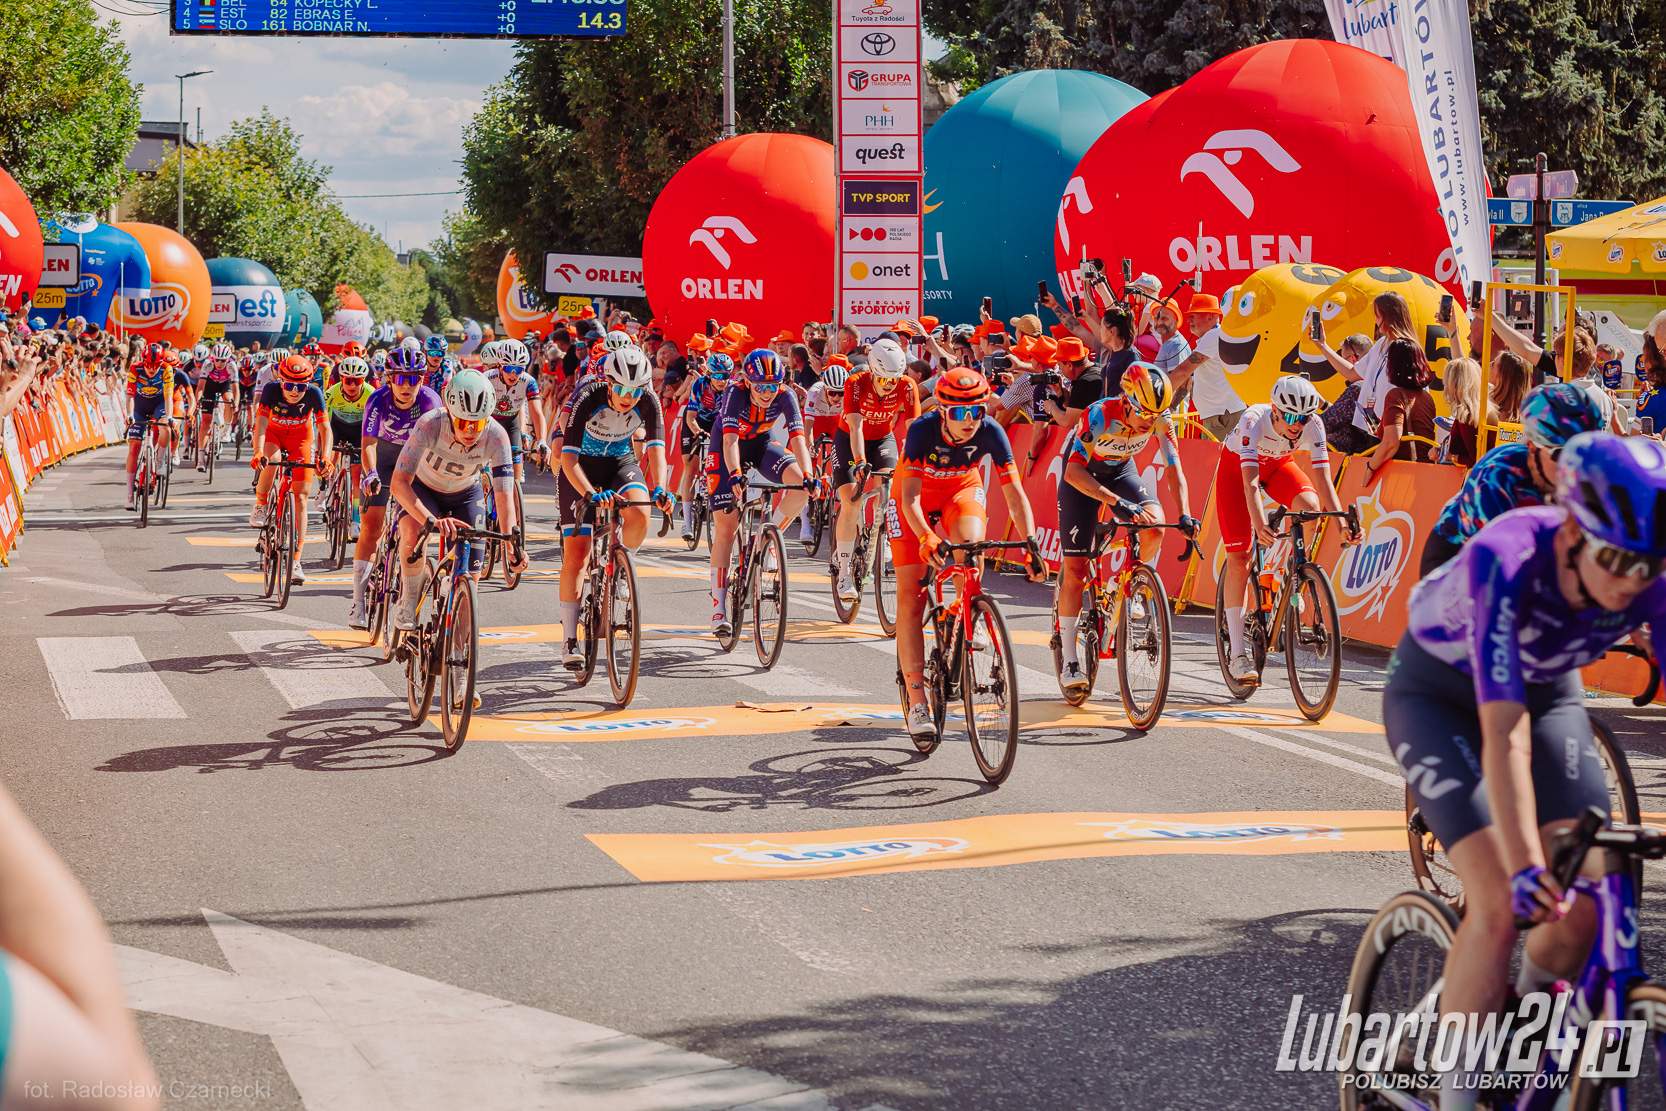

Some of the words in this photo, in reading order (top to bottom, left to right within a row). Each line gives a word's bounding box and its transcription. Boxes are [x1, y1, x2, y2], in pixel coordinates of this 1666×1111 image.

[183, 8, 191, 18] 4
[221, 8, 245, 19] EST
[269, 9, 288, 19] 82
[294, 9, 341, 20] EBRAS
[344, 10, 356, 20] E.
[497, 12, 516, 23] +0
[577, 12, 622, 29] 14.3
[183, 19, 191, 29] 5
[219, 19, 247, 30] SLO
[261, 19, 286, 31] 161
[293, 20, 354, 32] BOBNAR
[357, 21, 371, 32] N.
[498, 23, 515, 34] +0
[870, 73, 911, 82] GRUPA
[865, 115, 894, 127] PHH
[855, 143, 905, 165] quest
[851, 193, 874, 203] TVP
[876, 193, 911, 203] SPORT
[1168, 233, 1313, 273] ORLEN
[585, 267, 644, 284] ORLEN
[872, 263, 911, 277] onet
[681, 277, 763, 300] ORLEN
[36, 293, 63, 304] 25m
[129, 293, 176, 317] LOTTO
[851, 305, 911, 315] SPORTOWY
[1346, 536, 1398, 590] LOTTO
[1491, 596, 1516, 684] Jayco
[765, 841, 912, 861] LOTTO
